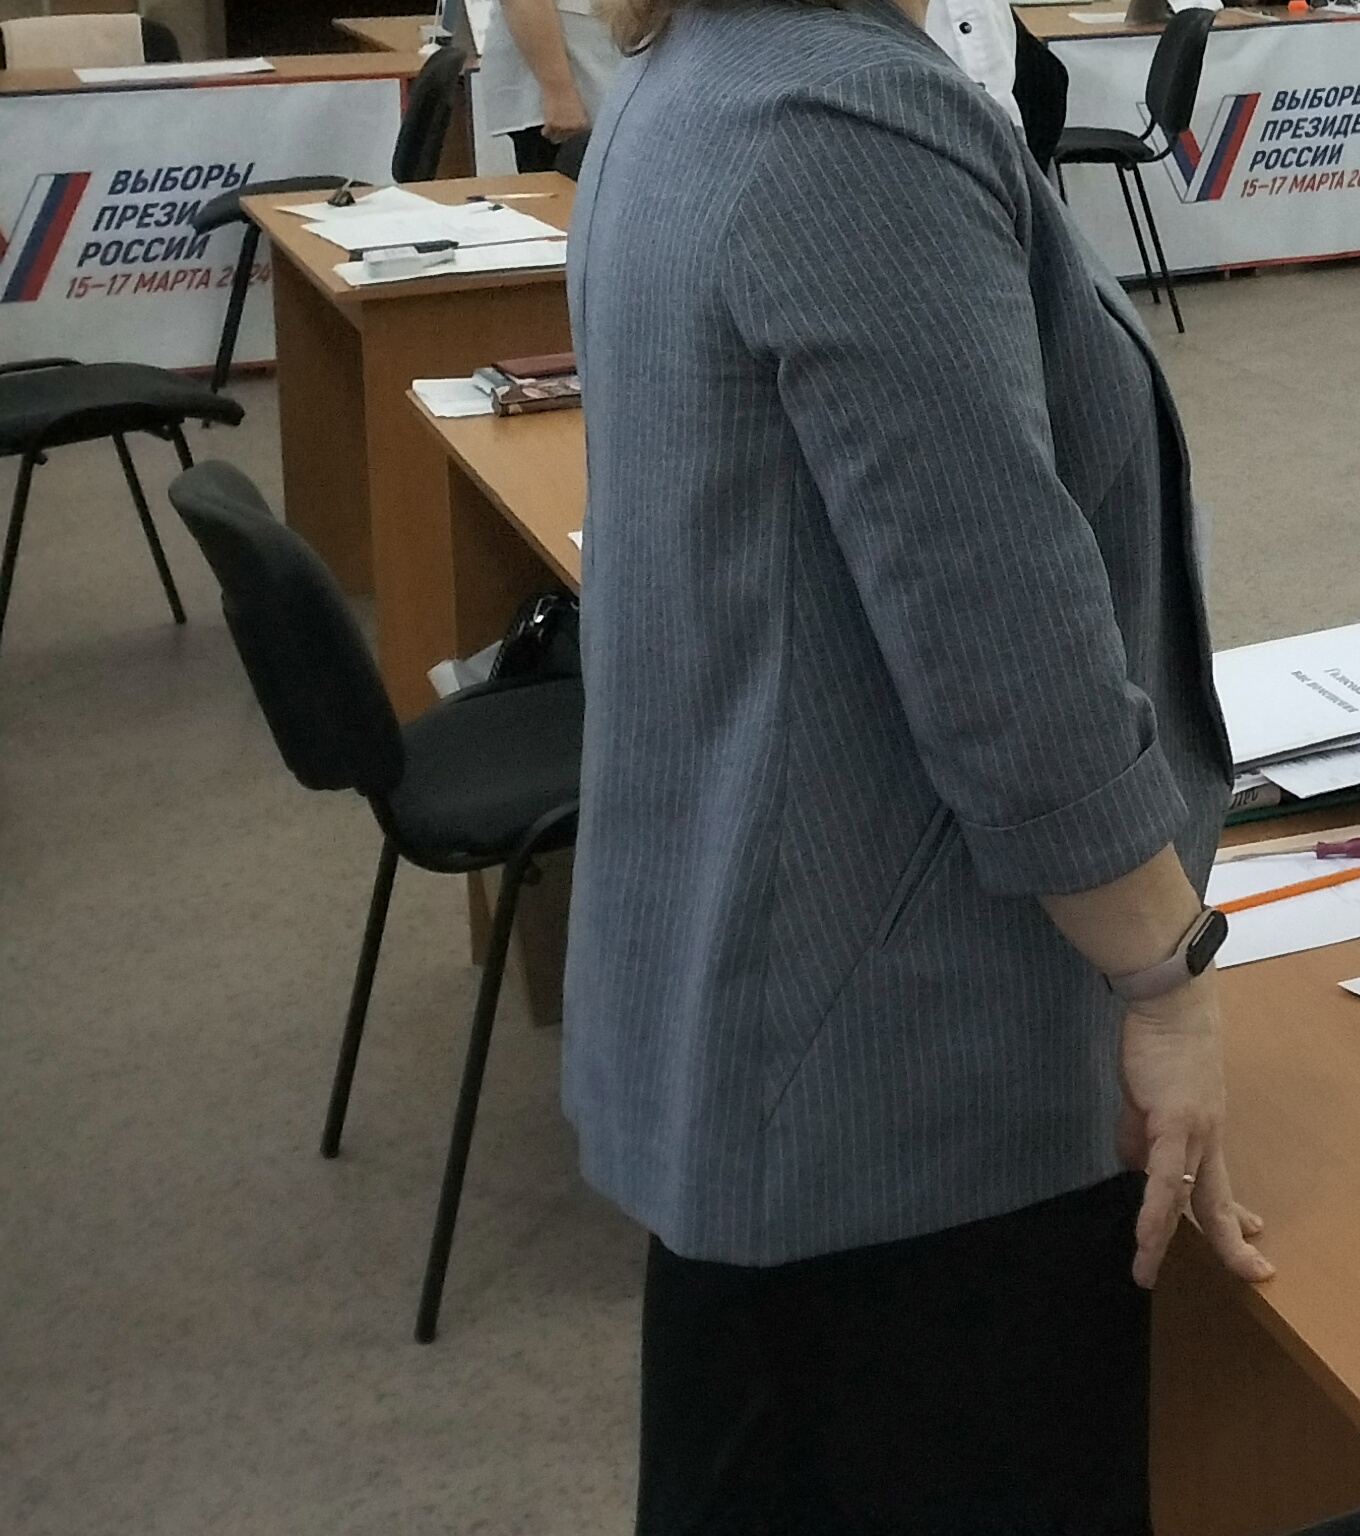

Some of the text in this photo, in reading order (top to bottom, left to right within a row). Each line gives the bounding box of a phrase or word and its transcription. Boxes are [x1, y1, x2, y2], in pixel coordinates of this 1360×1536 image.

[1249, 143, 1344, 172] РОССИИ
[108, 163, 255, 195] ВЫБОРЫ
[1289, 170, 1345, 194] МАРТА
[93, 200, 201, 231] ПРЕЗИ
[77, 234, 211, 268] РОССИИ
[134, 268, 210, 295] МАРТА
[216, 266, 271, 288] 224
